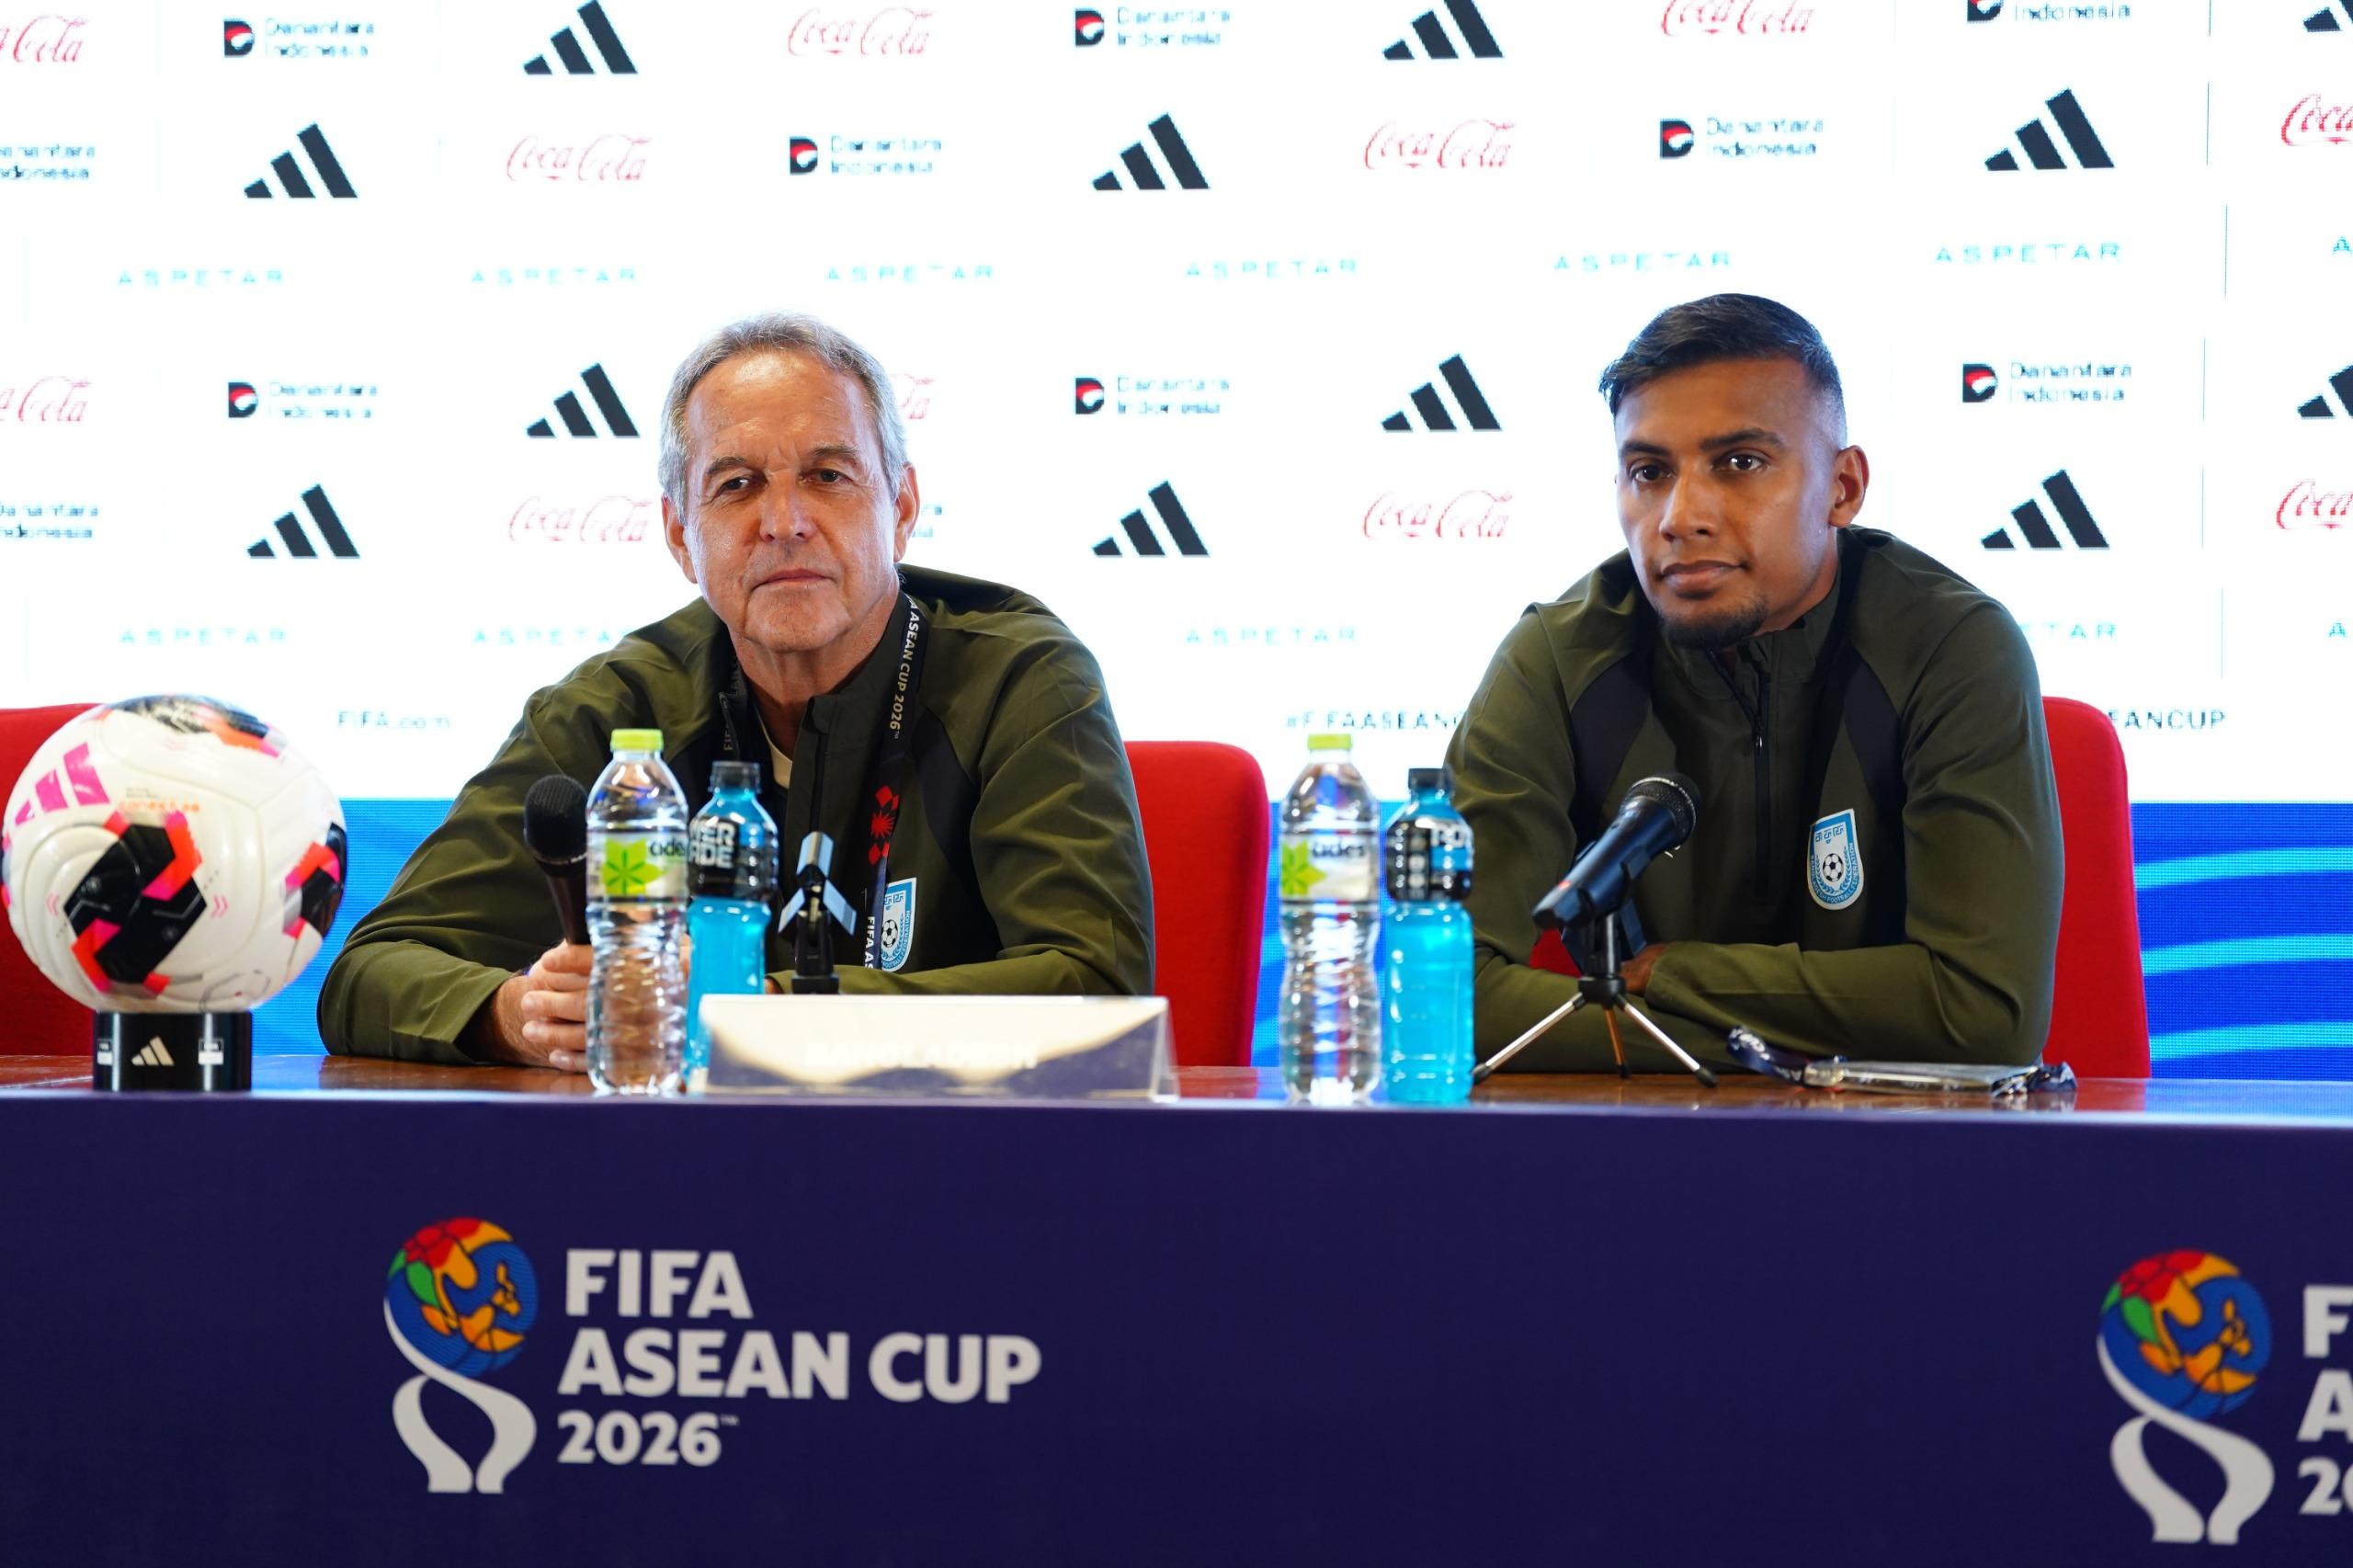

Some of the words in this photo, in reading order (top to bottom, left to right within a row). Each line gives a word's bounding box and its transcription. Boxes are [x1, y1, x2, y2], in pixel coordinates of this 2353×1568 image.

[903, 611, 920, 660] ASEAN
[897, 663, 911, 691] CUP
[866, 916, 875, 949] FIFA
[566, 1249, 753, 1319] FIFA
[558, 1328, 849, 1400] ASEAN
[869, 1333, 1041, 1403] CUP
